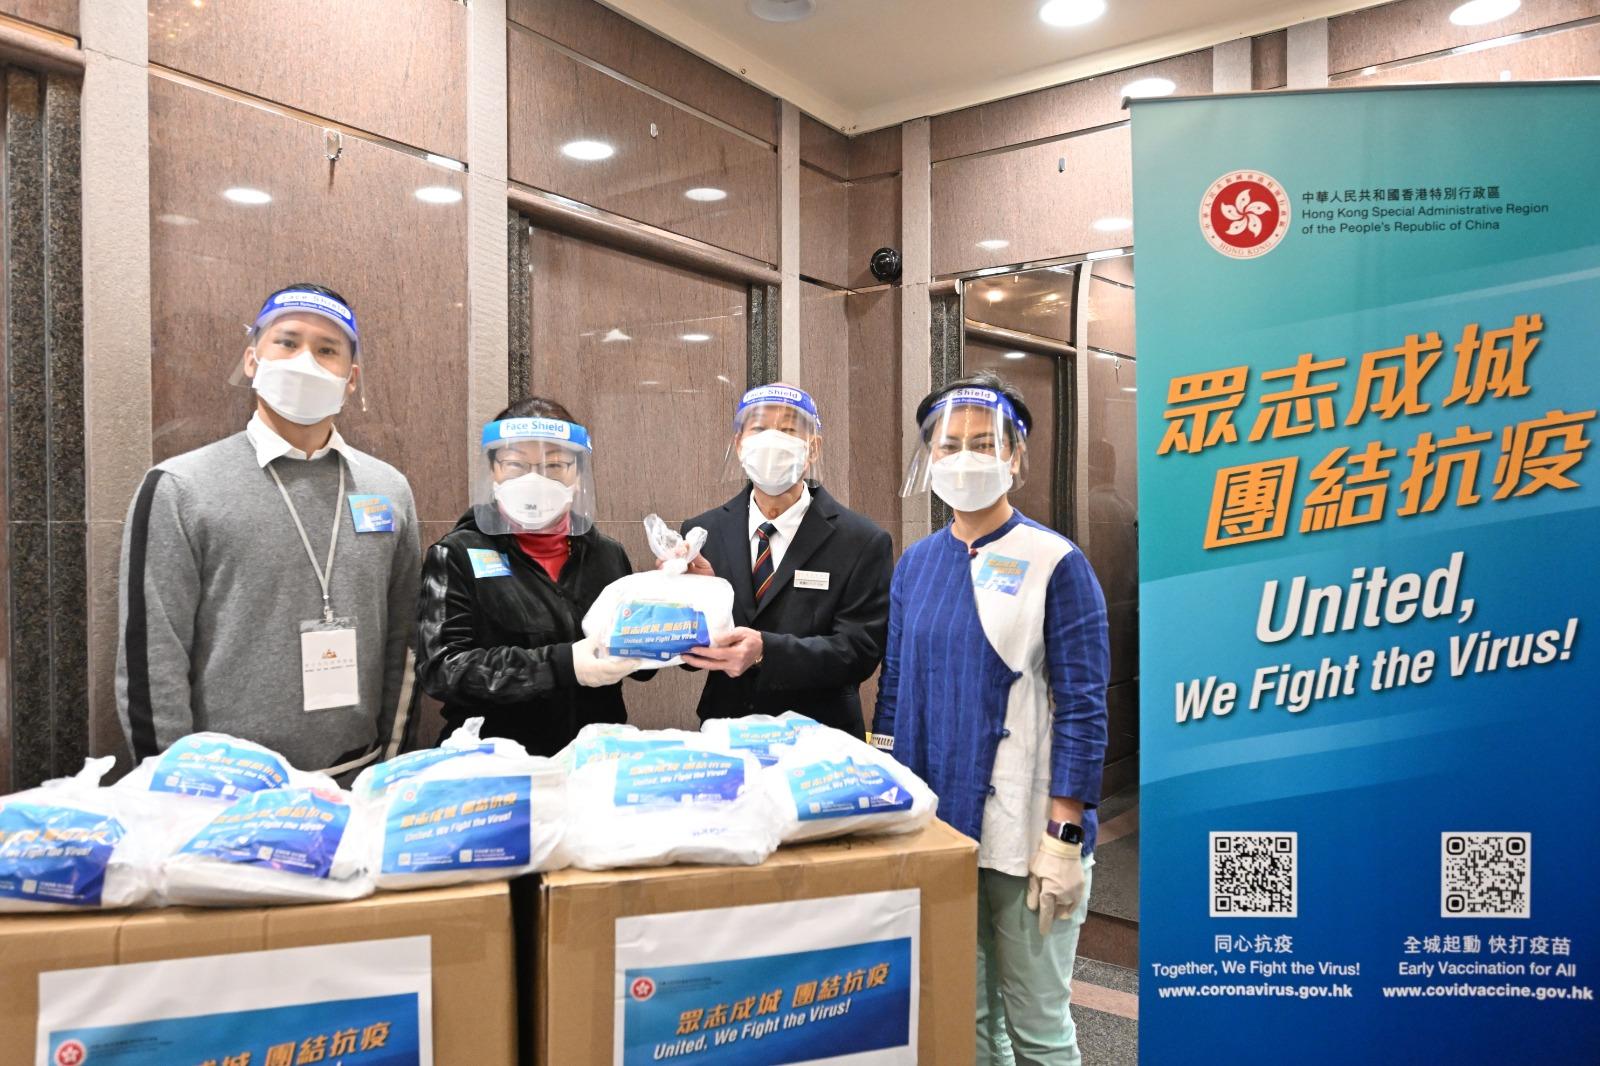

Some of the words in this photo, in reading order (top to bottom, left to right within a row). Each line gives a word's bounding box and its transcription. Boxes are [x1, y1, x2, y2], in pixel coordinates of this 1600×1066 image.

[1302, 185, 1500, 204] 中華人民共和國香港特別行政區
[1302, 209, 1334, 220] Hong
[1337, 207, 1369, 219] Kong
[1372, 206, 1415, 218] Special
[1417, 204, 1503, 216] Administrative
[1506, 203, 1549, 216] Region
[1302, 224, 1313, 234] of
[1317, 224, 1336, 234] the
[1340, 222, 1391, 234] People's
[1394, 220, 1446, 233] Republic
[1449, 220, 1462, 231] of
[1465, 218, 1500, 231] China
[767, 388, 799, 399] Shield
[957, 388, 992, 399] Shield
[1157, 314, 1544, 455] 眾志成城
[506, 422, 529, 431] Face
[531, 420, 565, 433] Shield
[1203, 408, 1597, 549] 團結抗疫
[1256, 551, 1475, 643] United,
[1175, 676, 1236, 723] We
[1249, 654, 1359, 712] Fight
[1371, 646, 1435, 690] the
[1449, 618, 1579, 677] Virus!
[1214, 934, 1293, 954] 同心抗疫
[1403, 934, 1481, 954] 全城起動
[1488, 935, 1571, 956] 快打疫苗
[1152, 961, 1217, 979] Together,
[1222, 960, 1246, 974] We
[1250, 961, 1287, 977] Fight
[1291, 961, 1315, 975] the
[1318, 962, 1360, 976] Virus!
[1398, 961, 1434, 978] Early
[1438, 961, 1525, 976] Vaccination
[1529, 962, 1551, 976] for
[1555, 963, 1577, 977] All
[676, 988, 783, 1035] 眾志成城
[791, 962, 890, 1009] 團結抗疫
[1158, 983, 1353, 999] www.coronavirus.gov.hk
[1382, 983, 1594, 1000] www.covidvaccine.gov.hk
[714, 1028, 738, 1046] We
[741, 1017, 780, 1040] Fight
[783, 1012, 806, 1030] the
[809, 997, 852, 1023] Virus!
